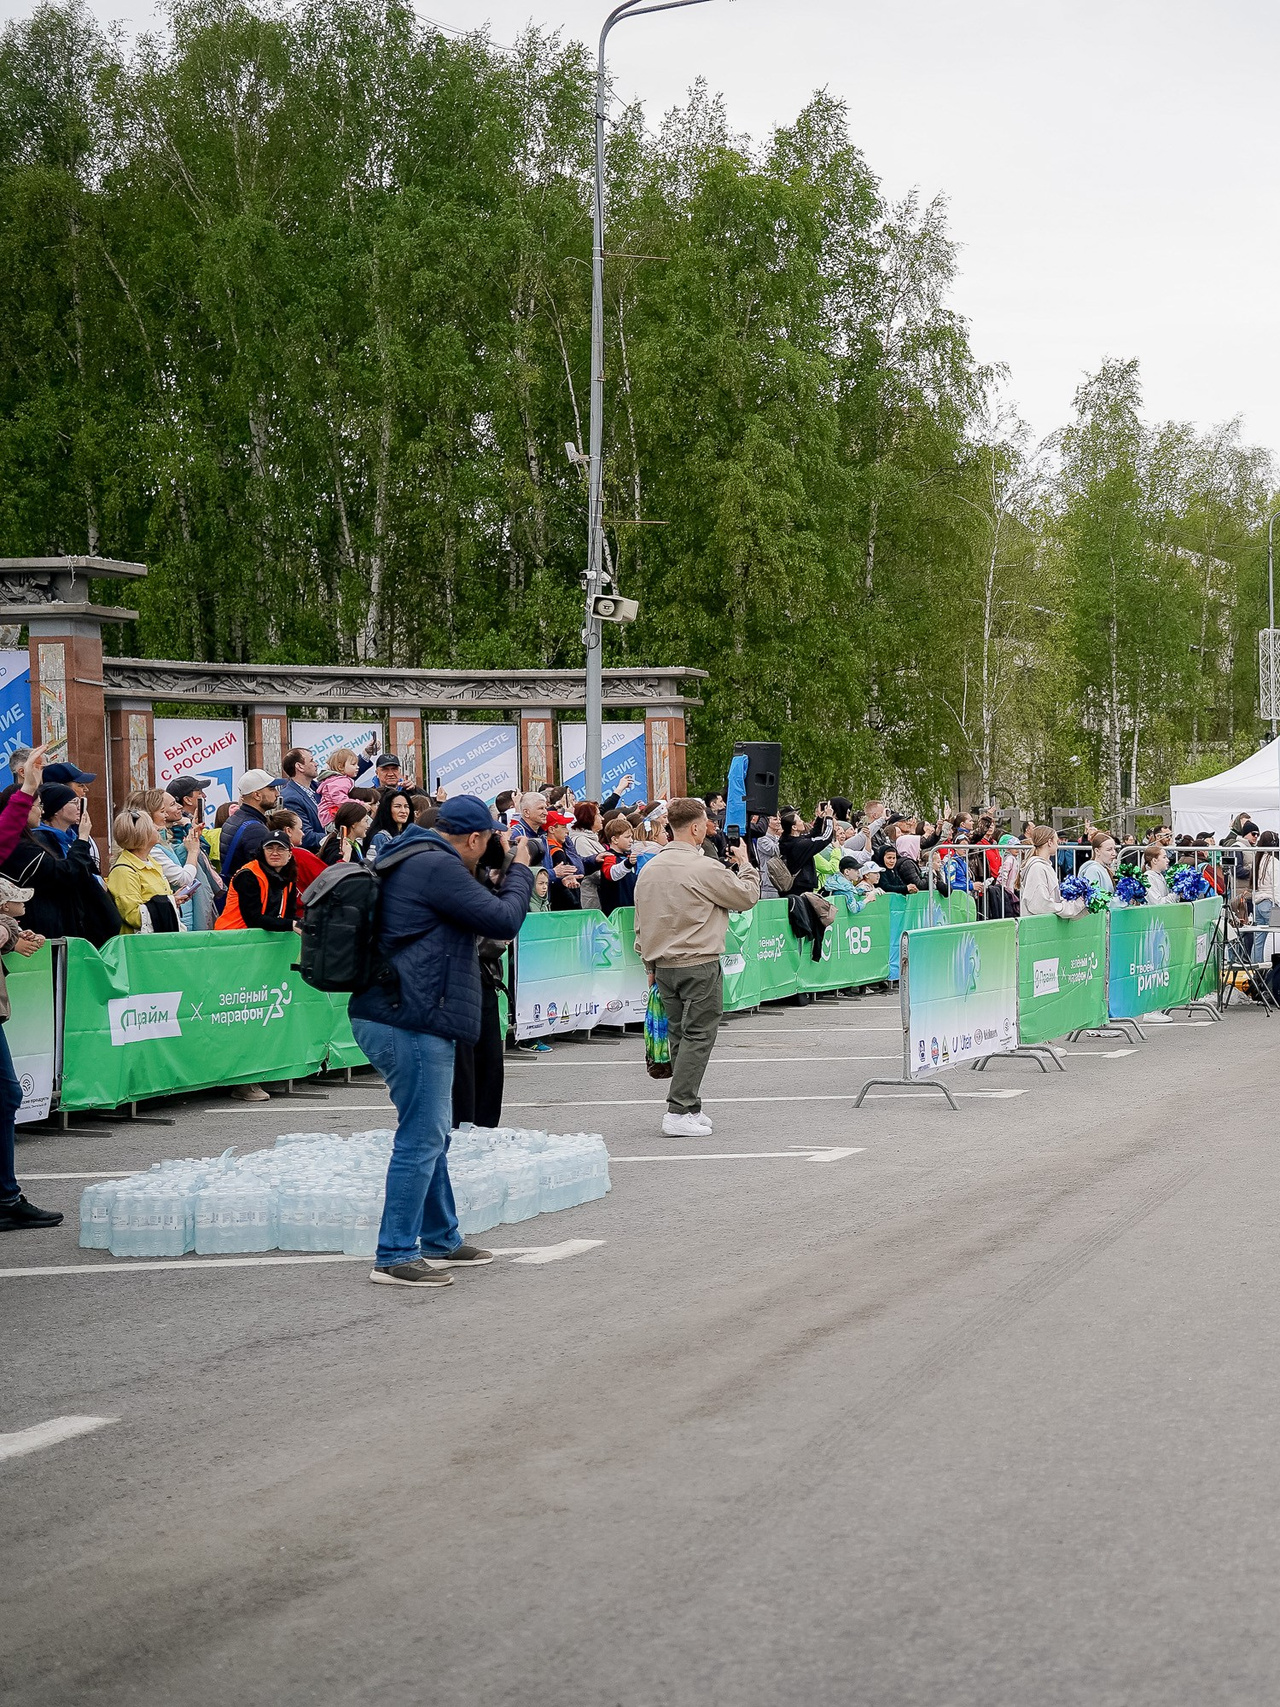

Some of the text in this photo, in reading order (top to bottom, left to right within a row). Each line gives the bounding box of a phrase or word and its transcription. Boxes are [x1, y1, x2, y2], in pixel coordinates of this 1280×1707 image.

[160, 731, 237, 781] С РОССИЕЙ
[163, 736, 203, 761] БЫТЬ
[436, 732, 509, 777] БЫТЬ ВМЕСТЕ
[461, 772, 490, 791] БЫТЬ
[467, 771, 510, 796] ОССИЕЙ
[845, 926, 871, 955] 185
[218, 985, 268, 1006] зелёный
[1137, 971, 1170, 997] ритме
[120, 1005, 169, 1032] Прайм
[211, 1005, 264, 1027] марафон
